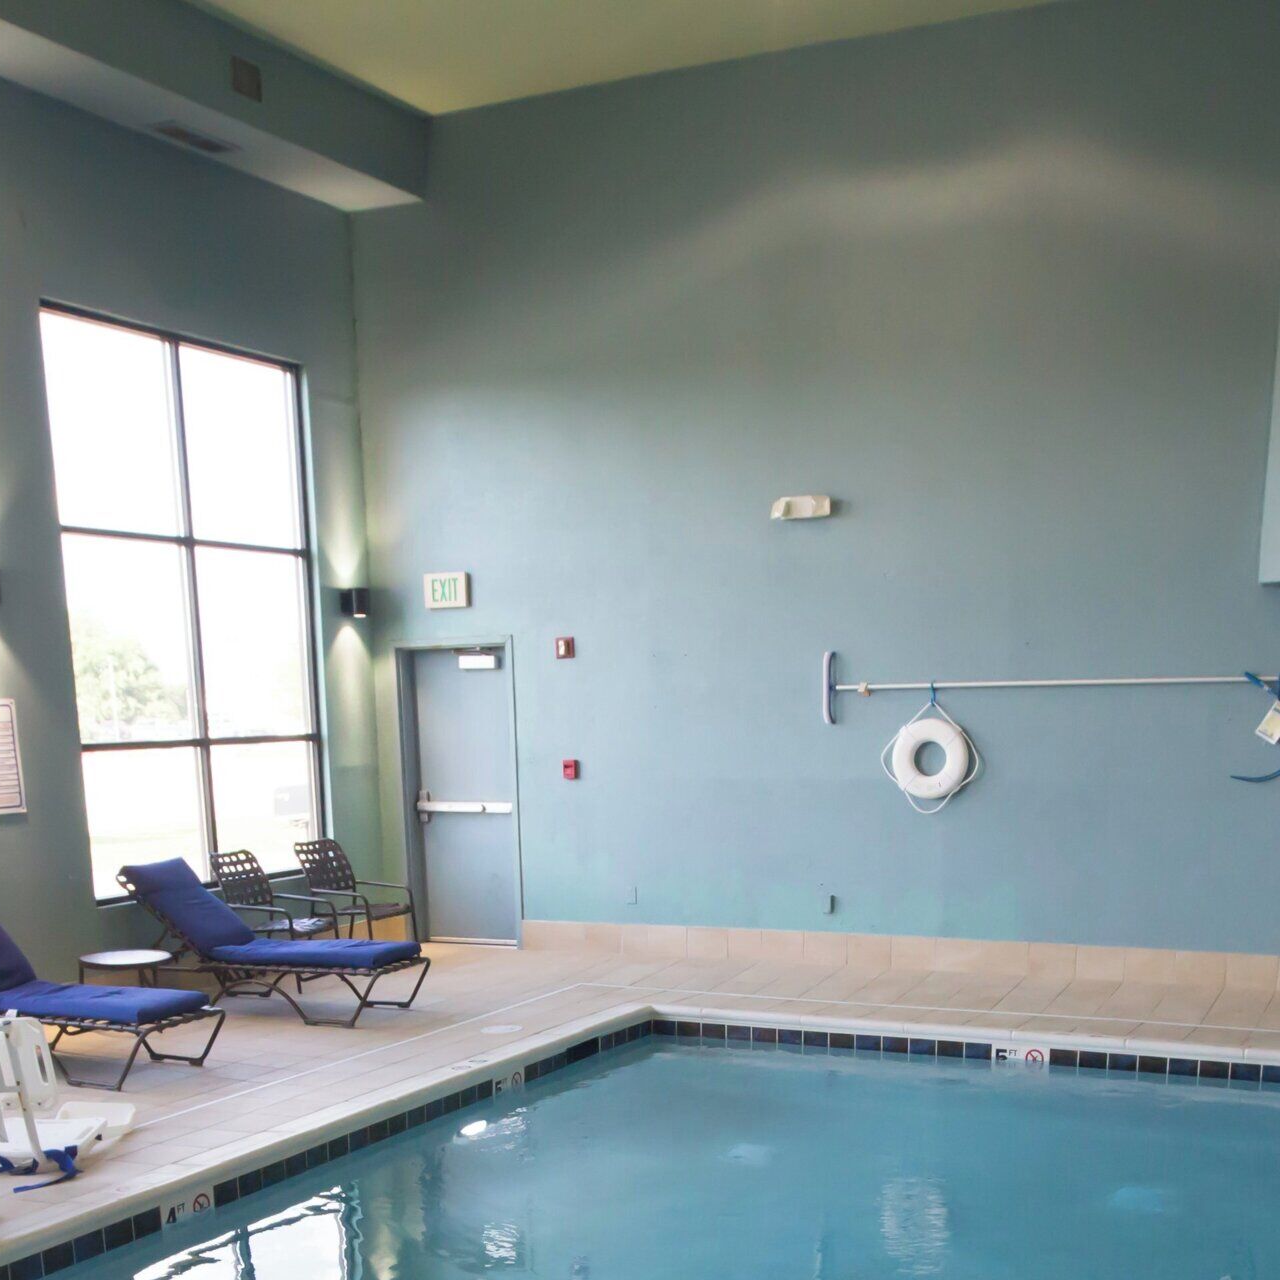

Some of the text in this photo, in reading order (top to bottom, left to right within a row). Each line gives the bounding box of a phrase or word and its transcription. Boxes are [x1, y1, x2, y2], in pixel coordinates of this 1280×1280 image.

[431, 577, 459, 602] EXIT
[995, 1048, 1008, 1061] 5
[177, 1202, 185, 1214] FT
